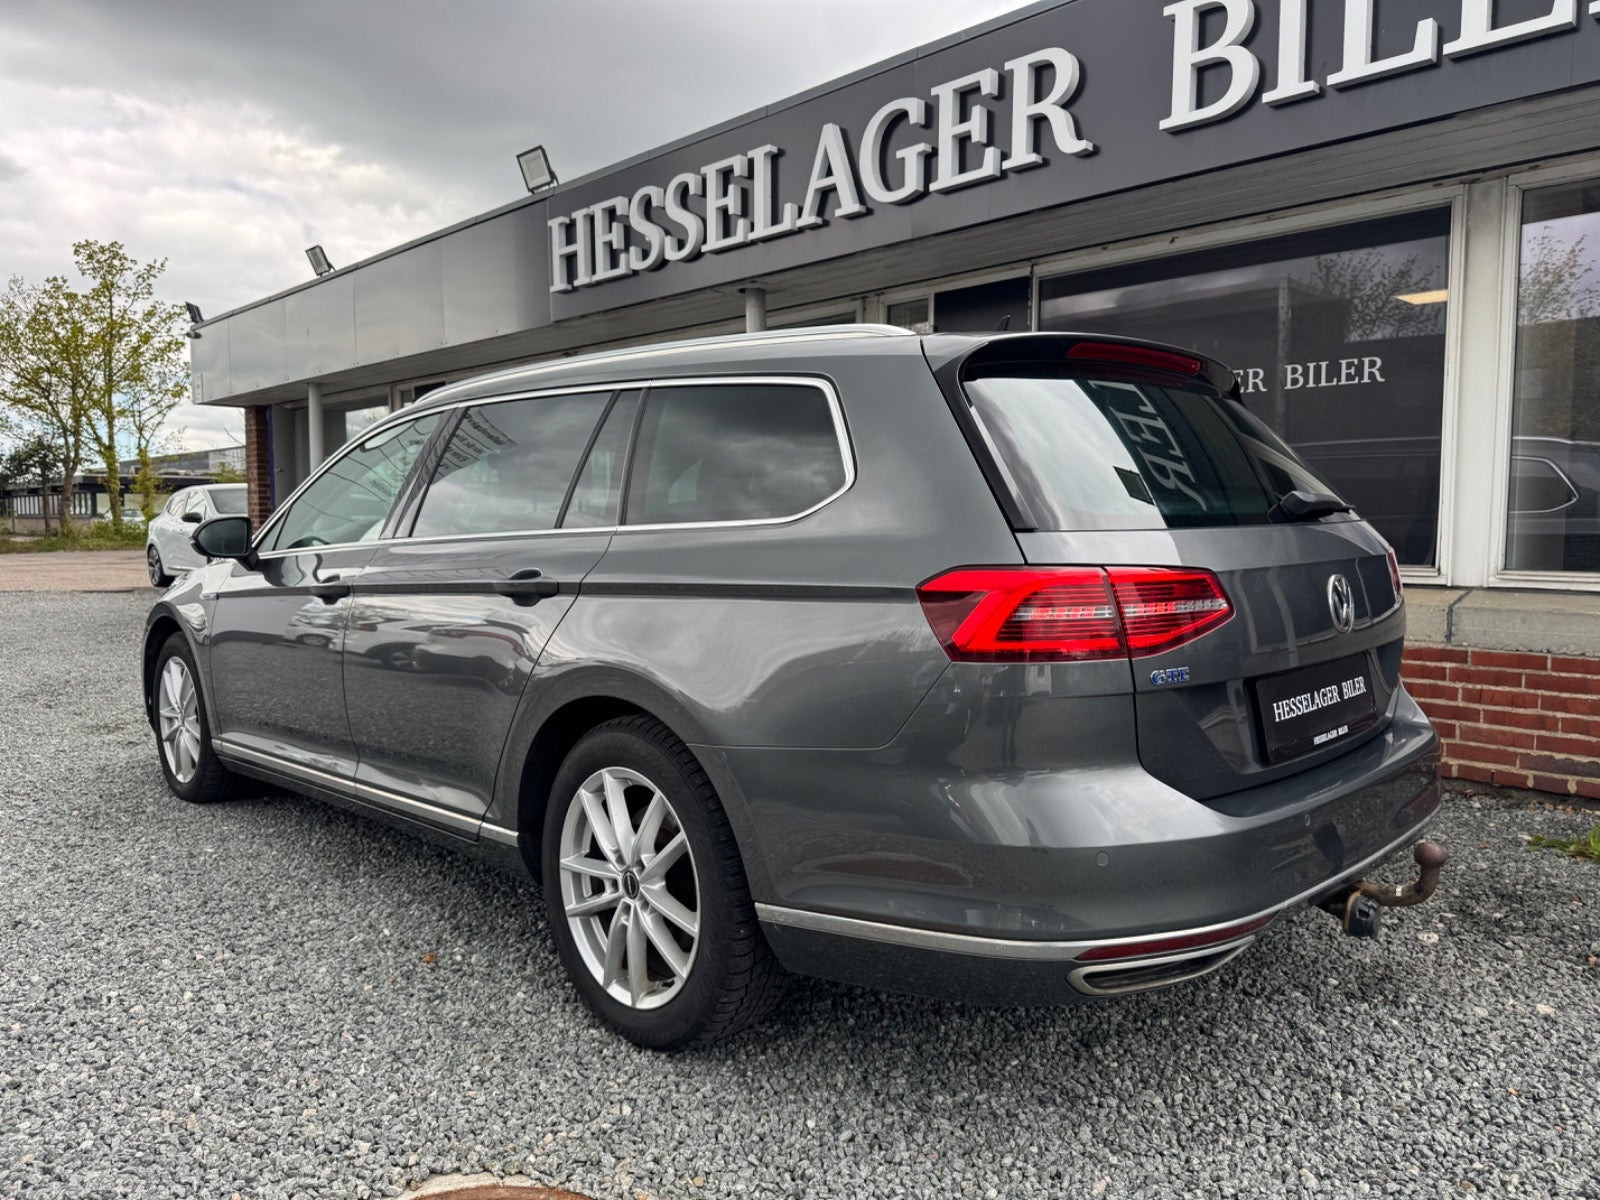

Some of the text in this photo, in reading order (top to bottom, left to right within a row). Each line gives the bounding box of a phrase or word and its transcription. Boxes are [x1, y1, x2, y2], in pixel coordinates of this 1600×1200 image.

[548, 0, 1600, 293] HESSELAGER BIL
[1283, 356, 1386, 391] BILER
[1150, 666, 1190, 685] GTE
[1272, 676, 1366, 722] HESSELAGER BILER
